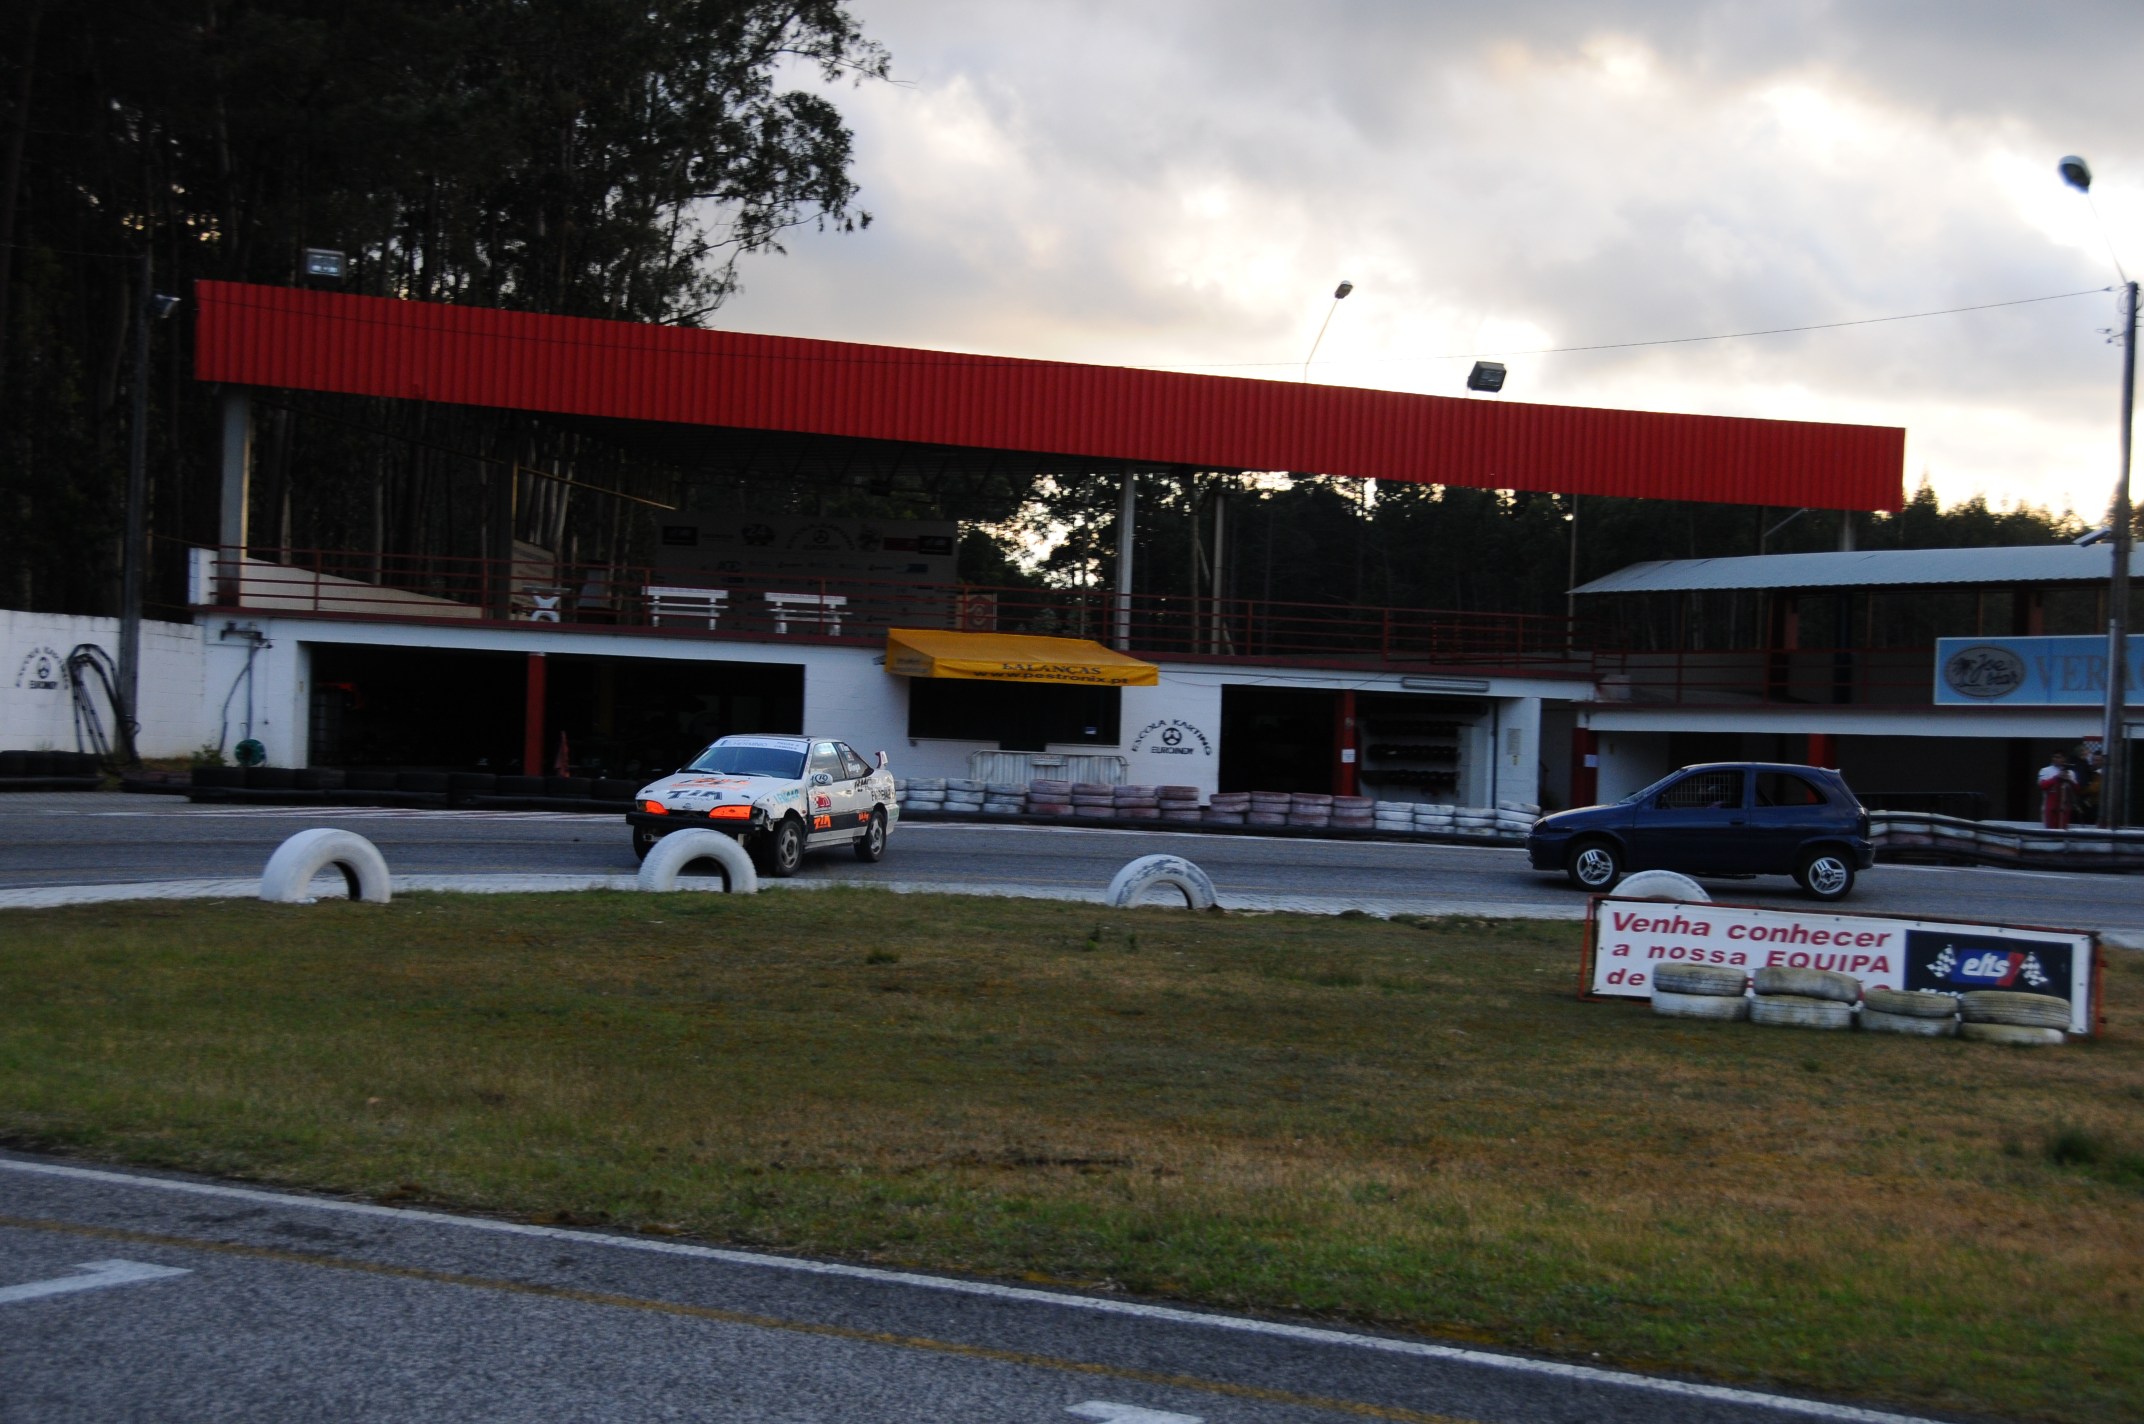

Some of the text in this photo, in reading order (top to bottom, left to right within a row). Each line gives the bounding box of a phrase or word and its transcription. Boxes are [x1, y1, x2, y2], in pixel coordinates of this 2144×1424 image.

[1612, 911, 1892, 948] Venha conhecer
[1611, 942, 1891, 973] a nossa EQUIPA
[1606, 968, 1646, 987] de
